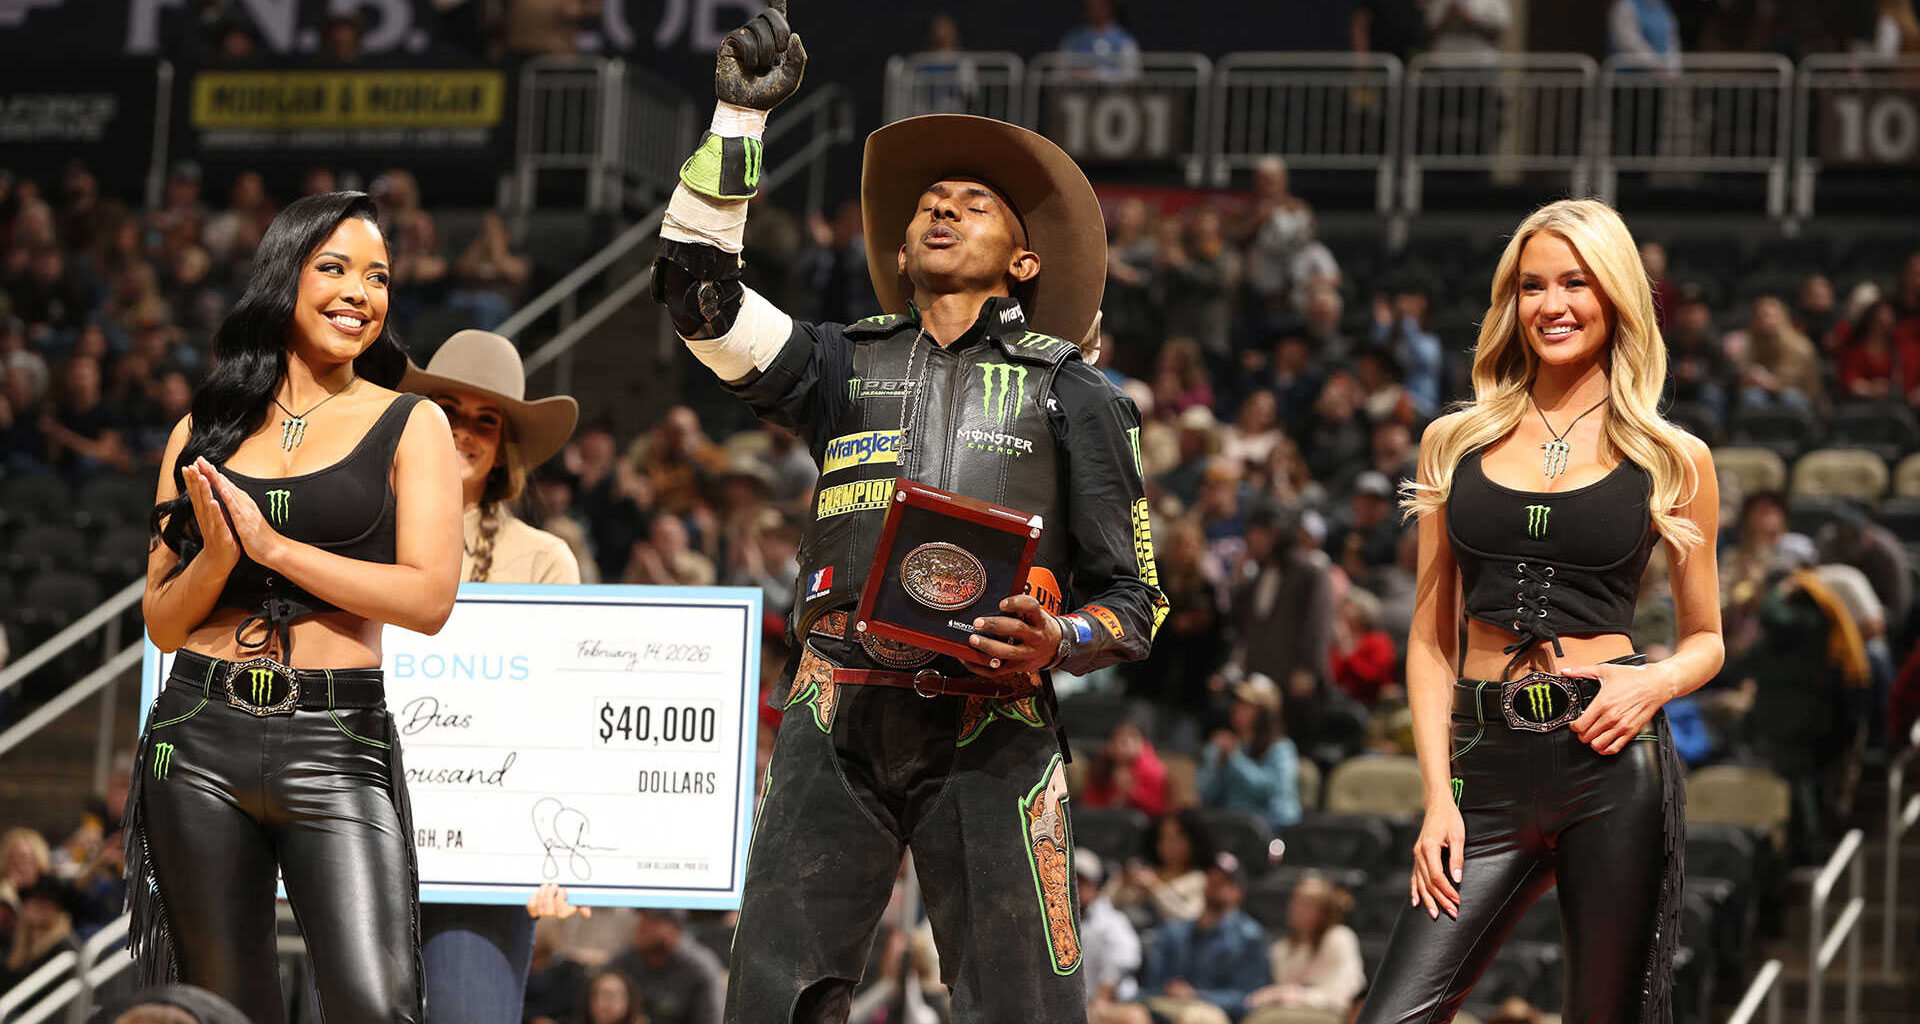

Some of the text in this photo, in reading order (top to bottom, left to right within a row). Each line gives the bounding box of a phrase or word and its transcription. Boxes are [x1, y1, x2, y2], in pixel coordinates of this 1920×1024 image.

[1062, 95, 1169, 157] 101
[1833, 97, 1918, 161] 10
[826, 433, 900, 462] Wrangler
[967, 442, 1022, 457] ENERGY
[818, 480, 896, 513] CHAMPION
[394, 653, 529, 681] BONUS
[577, 639, 638, 672] February
[665, 643, 711, 662] 2026
[402, 696, 473, 736] Dias
[599, 701, 716, 746] $40,000
[404, 751, 517, 787] ousand
[638, 770, 716, 795] DOLLARS
[446, 829, 464, 848] PA
